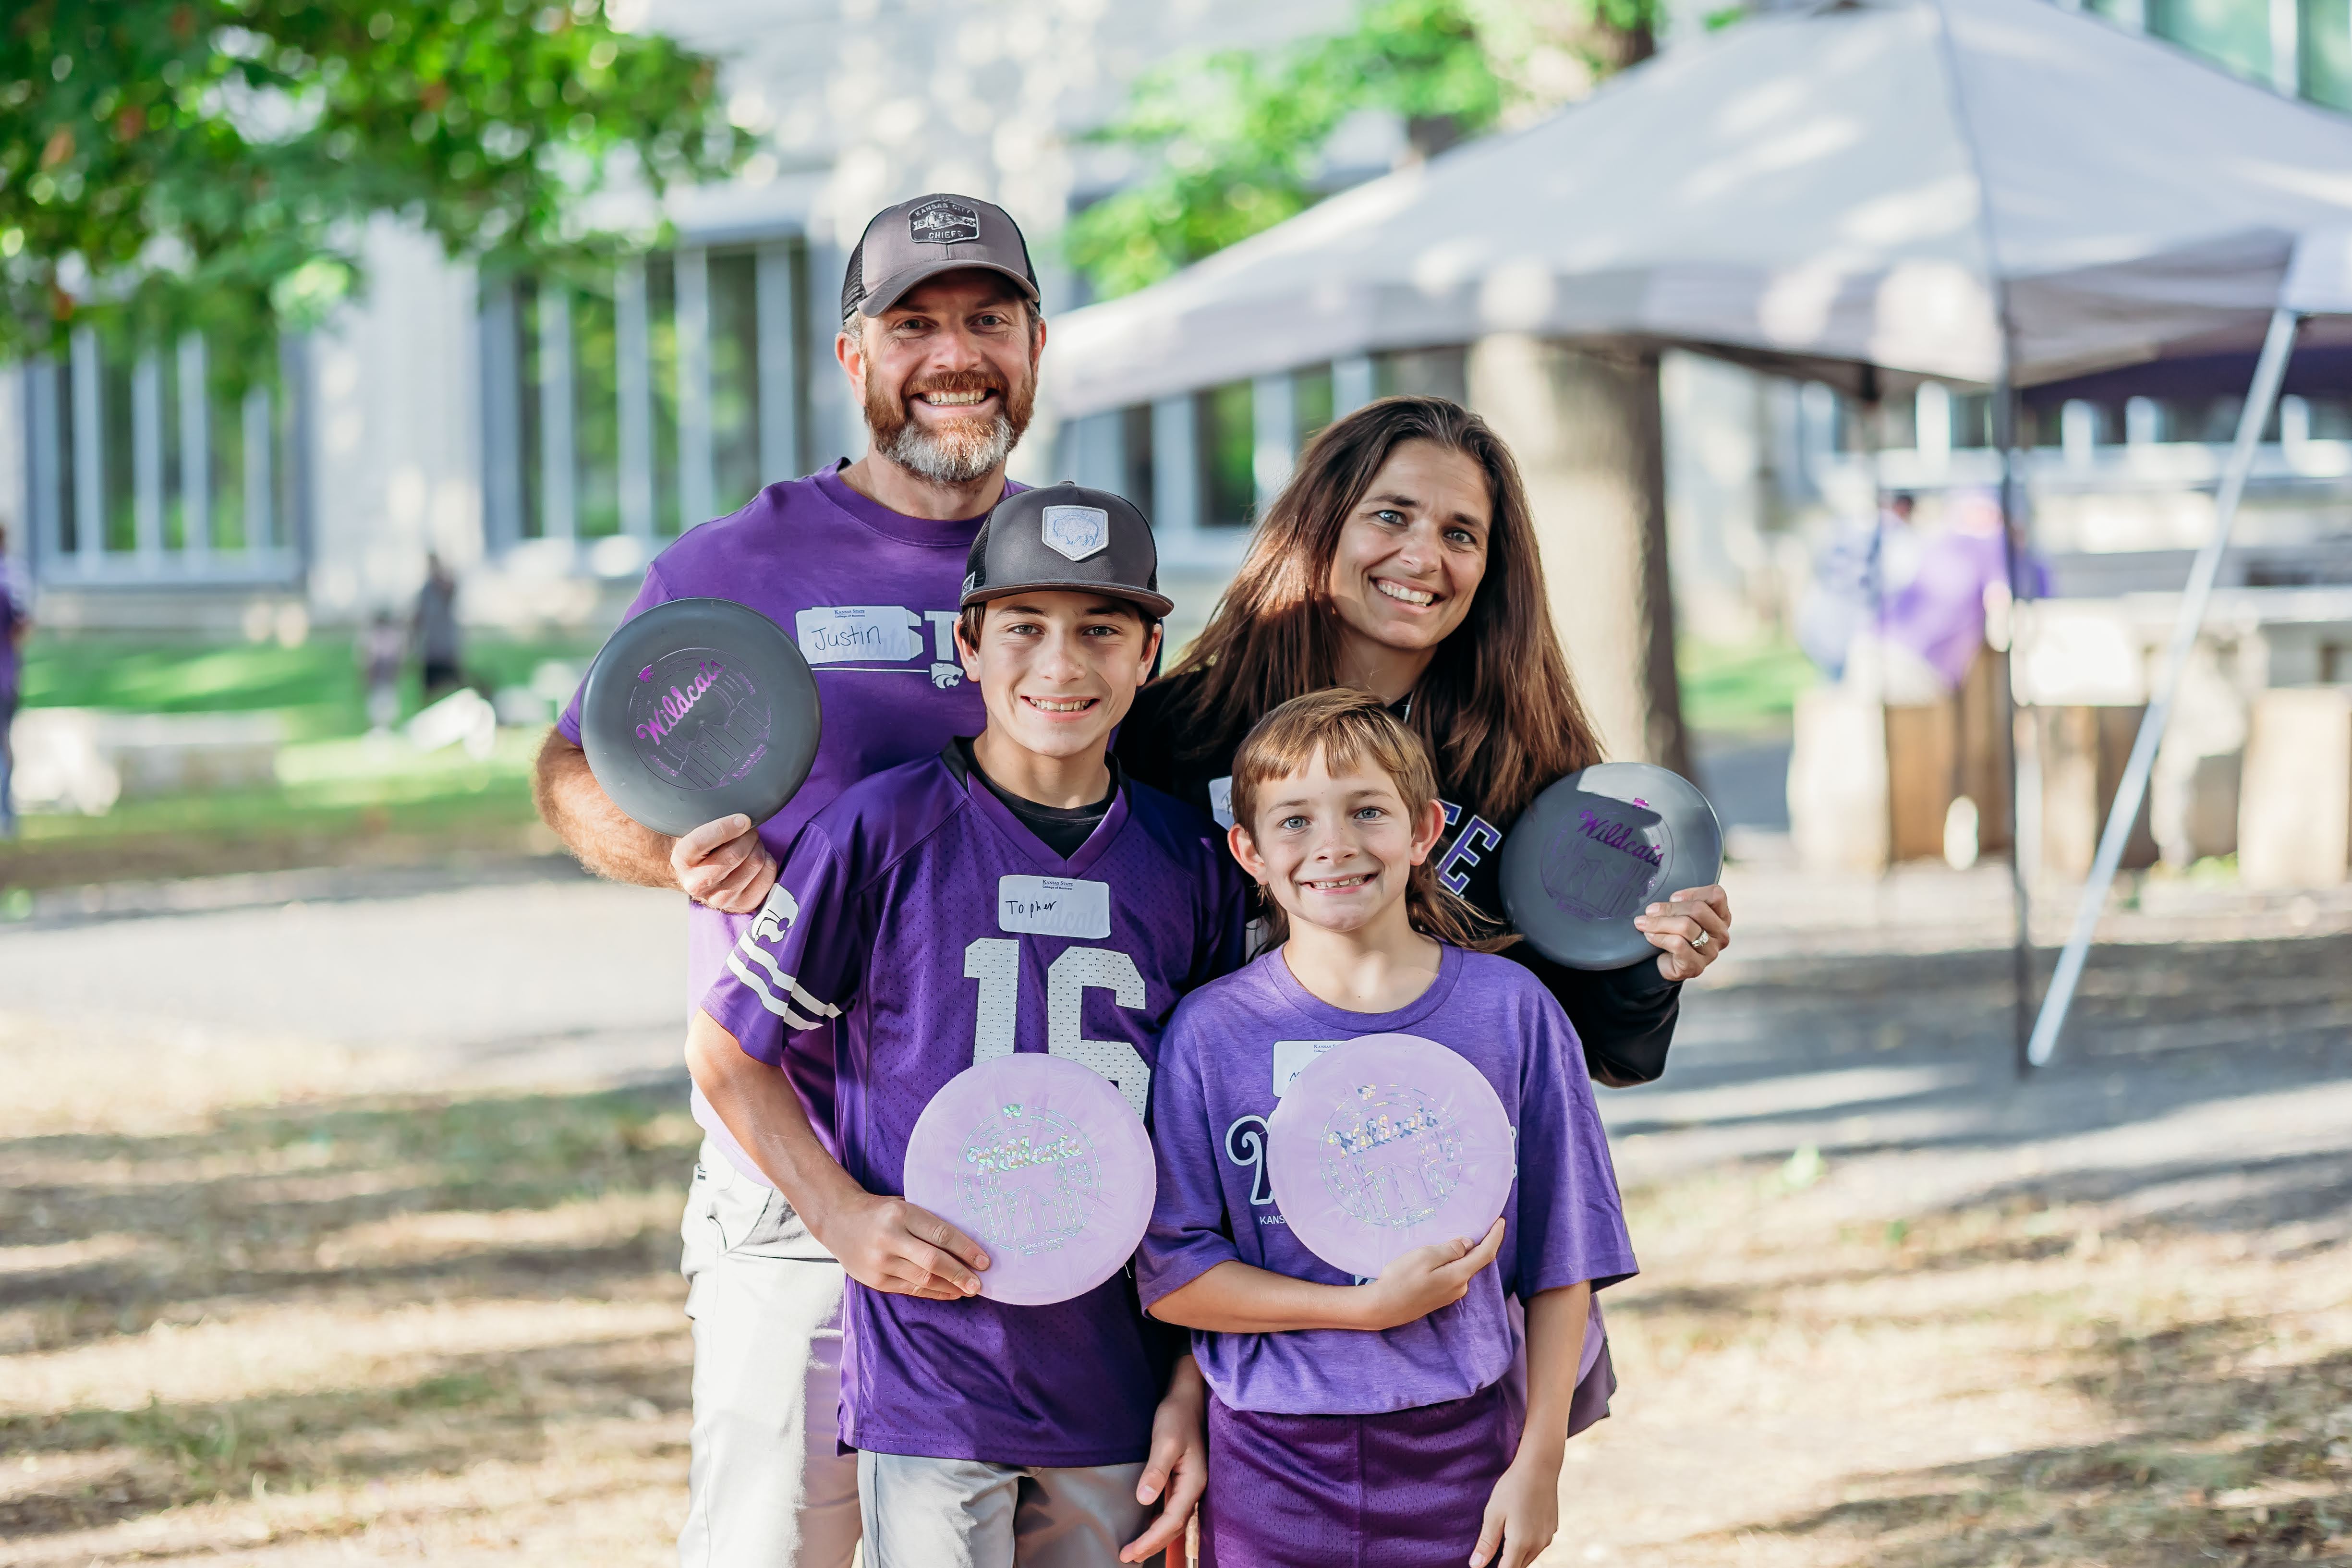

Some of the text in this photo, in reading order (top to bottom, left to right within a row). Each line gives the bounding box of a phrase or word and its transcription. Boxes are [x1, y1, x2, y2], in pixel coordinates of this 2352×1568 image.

[914, 203, 970, 216] KANSAS CITY
[928, 231, 963, 239] CHIEFS
[811, 625, 881, 651] Justin
[636, 658, 727, 745] Wildcats
[1576, 810, 1665, 867] Wildcats
[1005, 900, 1057, 918] Topher
[964, 937, 1151, 1125] 16
[1328, 1106, 1438, 1159] Wildcats
[966, 1135, 1083, 1177] Wildcats
[1417, 1207, 1435, 1217] STATE
